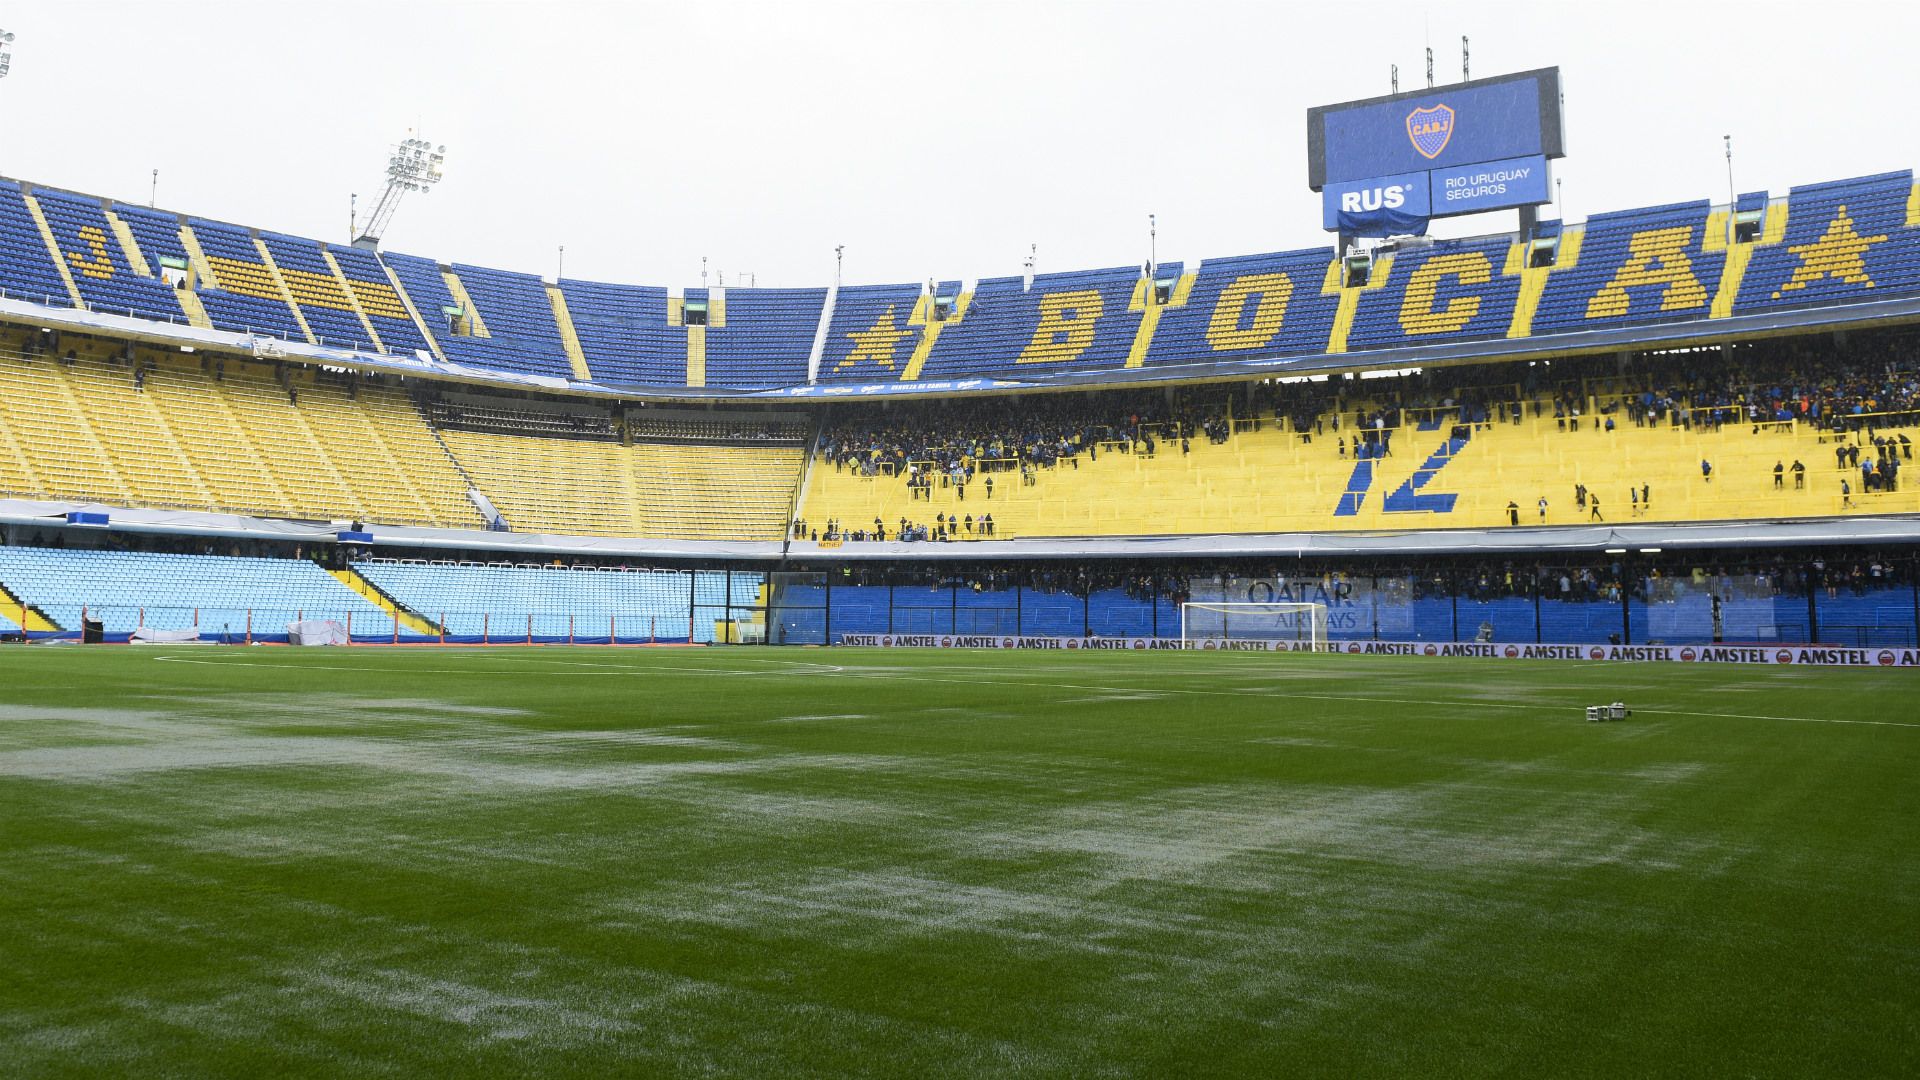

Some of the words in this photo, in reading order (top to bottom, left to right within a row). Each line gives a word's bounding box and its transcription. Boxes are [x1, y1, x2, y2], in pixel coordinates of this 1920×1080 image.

[1412, 119, 1449, 136] CABJ
[1446, 176, 1467, 189] RIO
[1470, 167, 1531, 186] URUGUAY
[1341, 185, 1405, 213] RUS
[1446, 183, 1507, 201] SEGUROS
[1248, 581, 1355, 611] QATAR
[1274, 611, 1357, 629] AIRWAYS
[895, 636, 937, 647] AMSTEL
[955, 637, 998, 648] AMSTEL
[1017, 638, 1062, 649] AMSTEL
[1081, 639, 1128, 650] AMSTEL
[1149, 640, 1196, 650] AMSTEL
[1220, 641, 1268, 651] AMSTEL
[1292, 642, 1342, 653] AMSTEL
[1365, 643, 1418, 655] AMSTEL
[1441, 644, 1498, 657] AMSTEL
[1523, 646, 1583, 659] AMSTEL
[1609, 647, 1673, 661] AMSTEL
[1701, 648, 1769, 663] AMSTEL
[1798, 650, 1870, 664] AMSTEL
